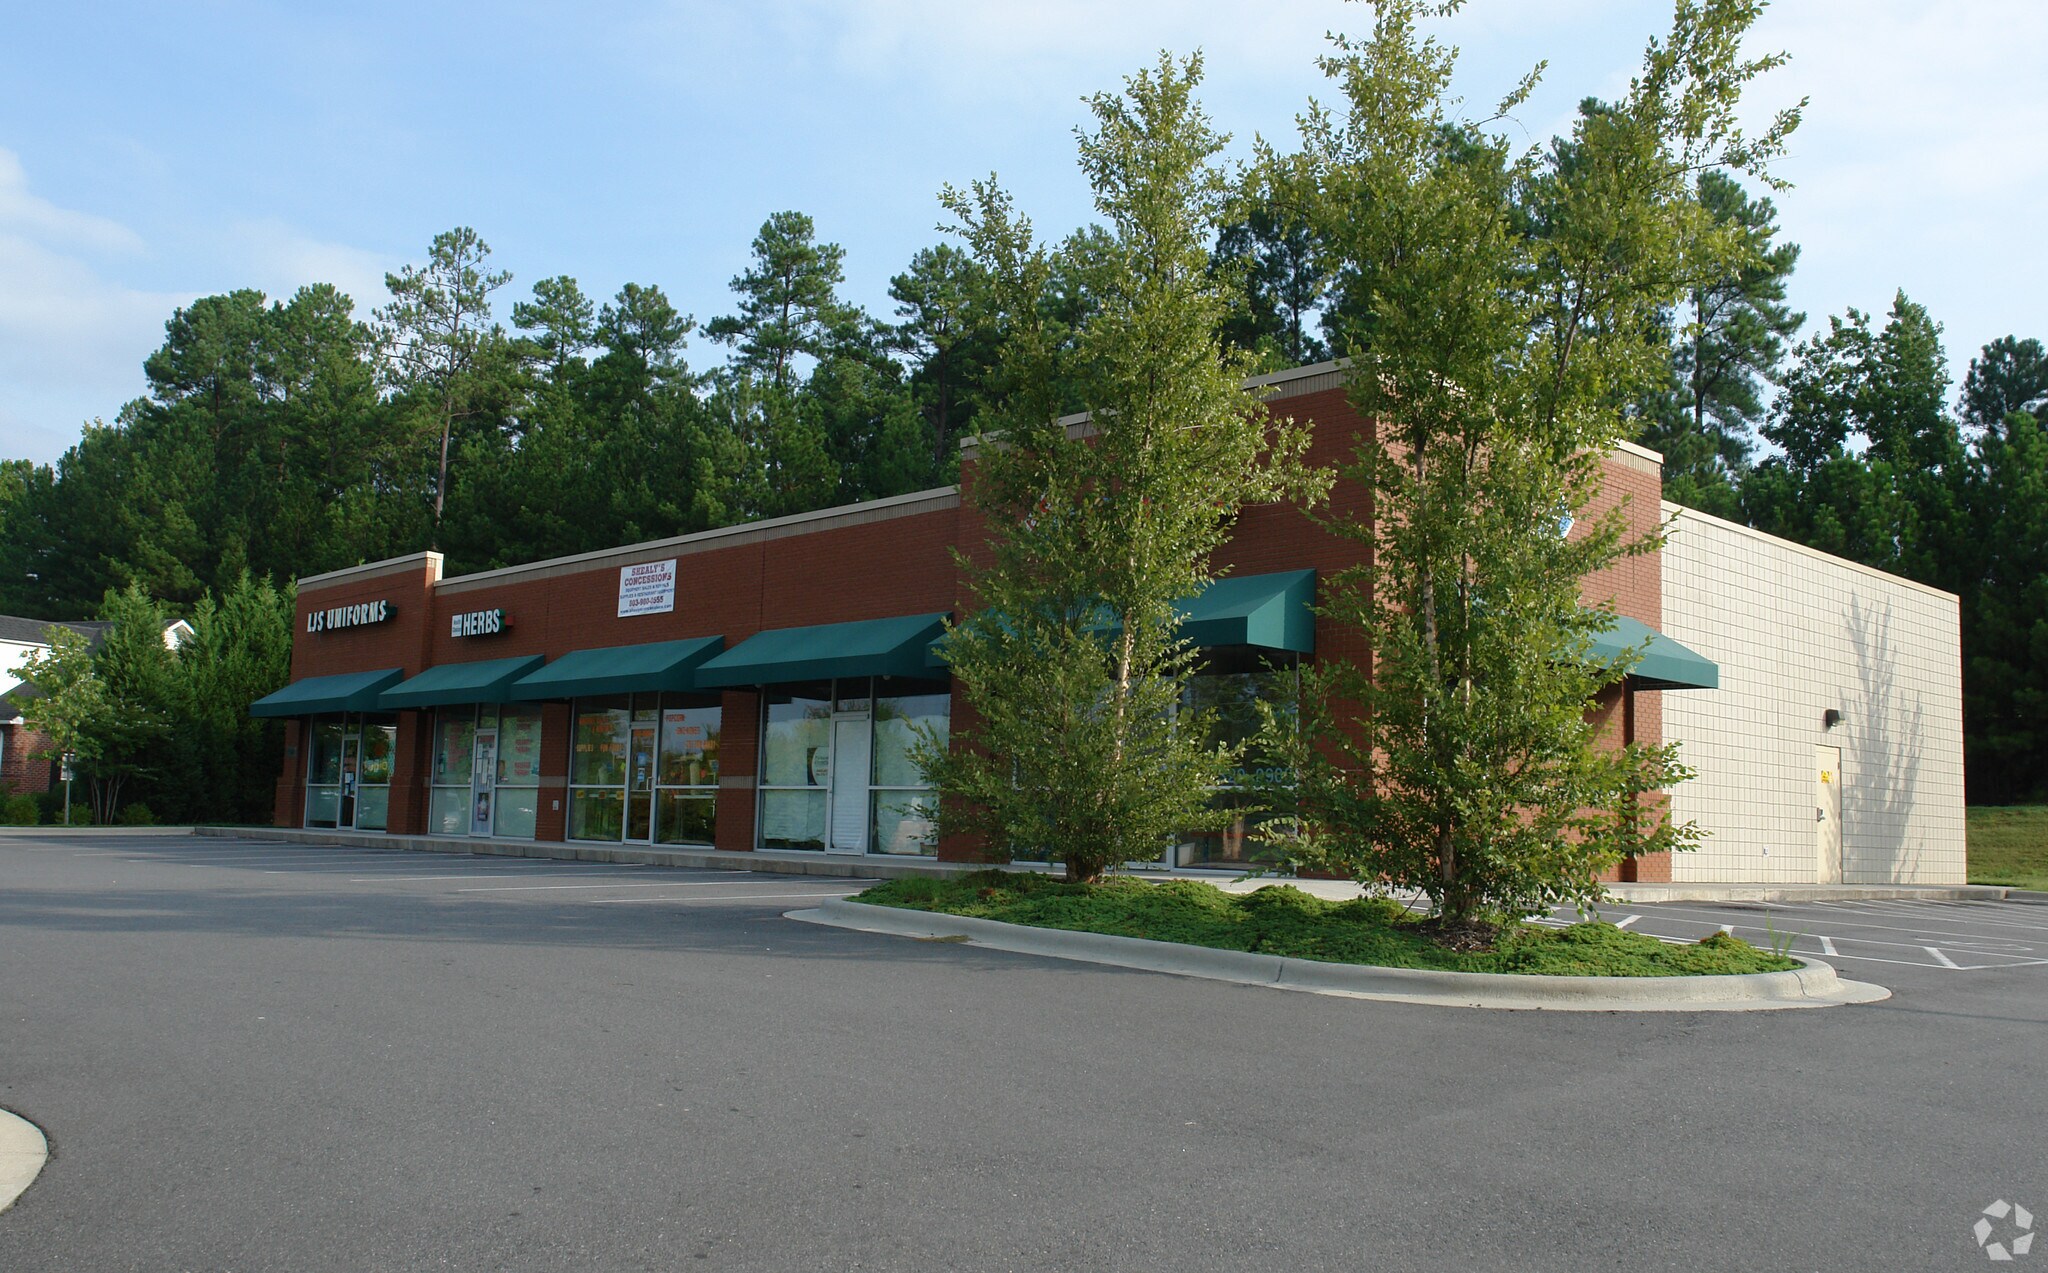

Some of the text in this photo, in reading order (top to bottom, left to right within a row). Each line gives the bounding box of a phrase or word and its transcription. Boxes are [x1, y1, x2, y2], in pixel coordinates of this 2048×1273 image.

[624, 572, 672, 587] CONCESSIONS
[631, 563, 666, 576] SHEALY'S
[326, 599, 387, 630] UNIFORMS
[463, 608, 500, 636] HERBS
